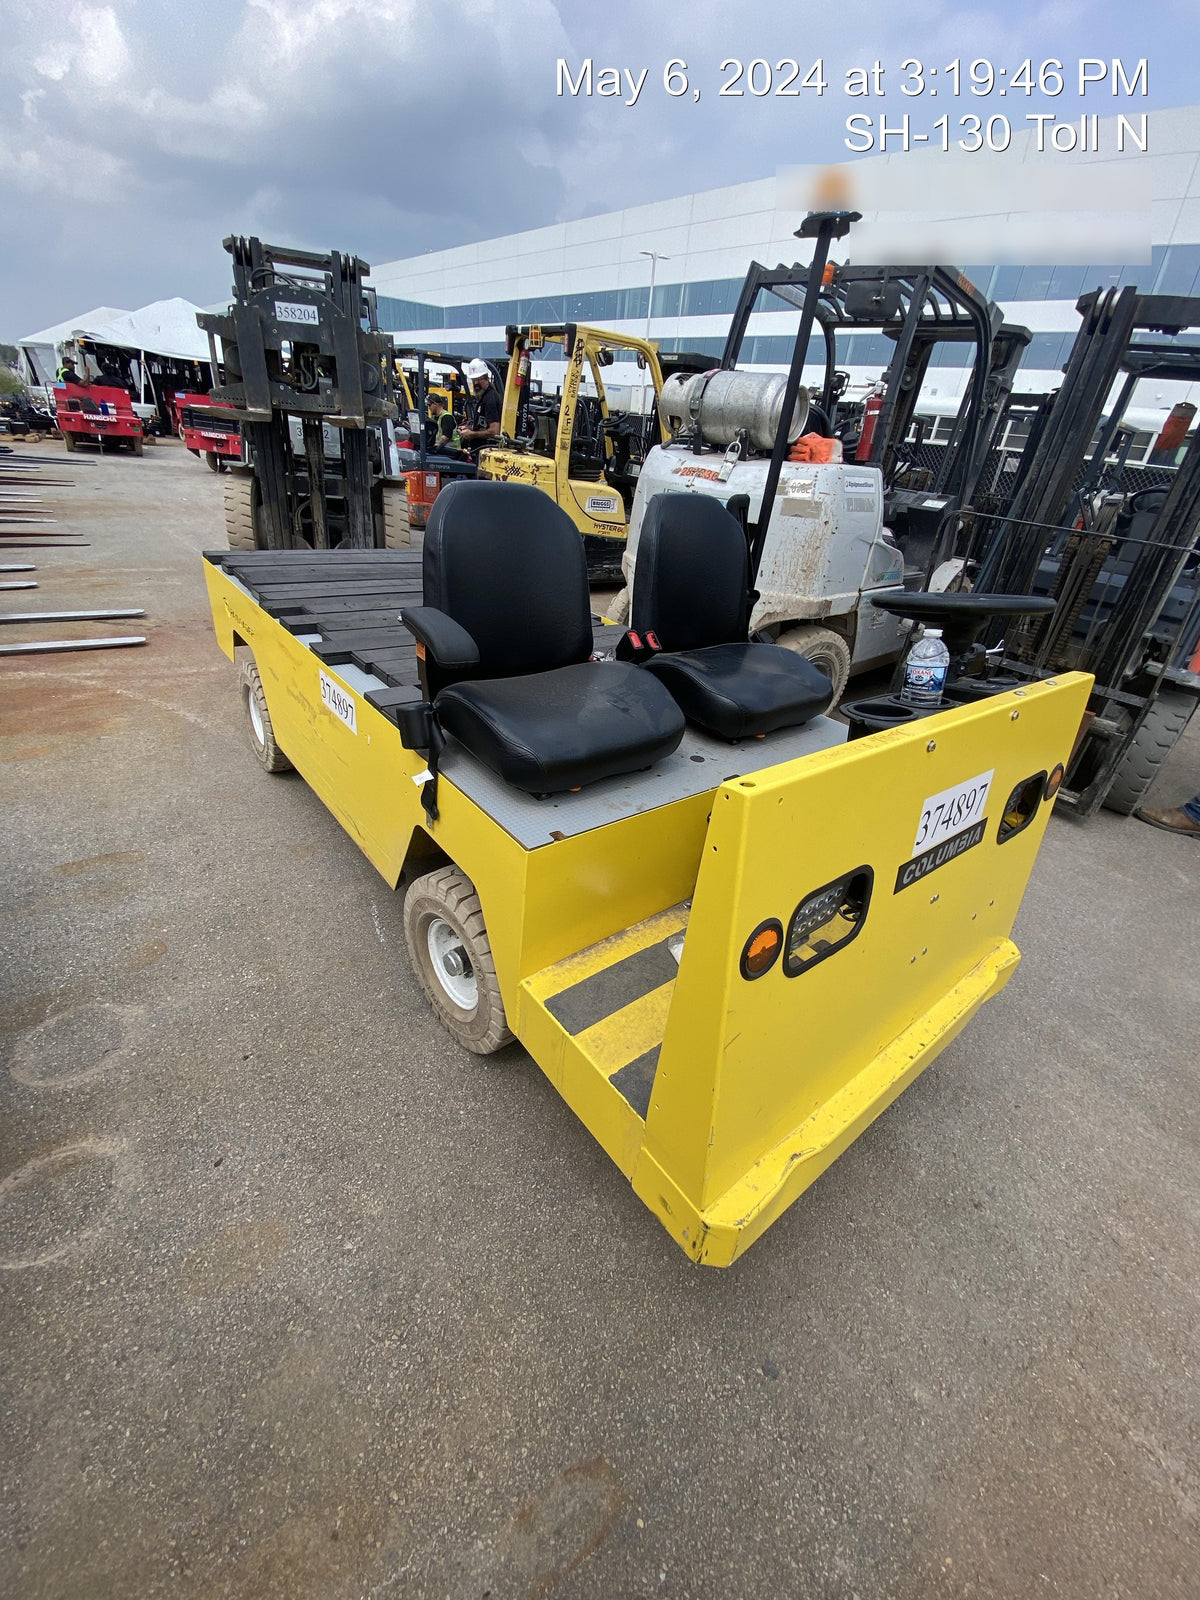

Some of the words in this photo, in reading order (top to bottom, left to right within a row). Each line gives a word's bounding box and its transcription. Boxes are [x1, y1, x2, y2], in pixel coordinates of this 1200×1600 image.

[277, 306, 316, 321] 358204
[564, 405, 570, 415] 2
[83, 414, 117, 422] HANGCHA
[593, 523, 618, 532] HYSTER
[320, 677, 353, 726] 374897
[915, 782, 989, 846] 374897
